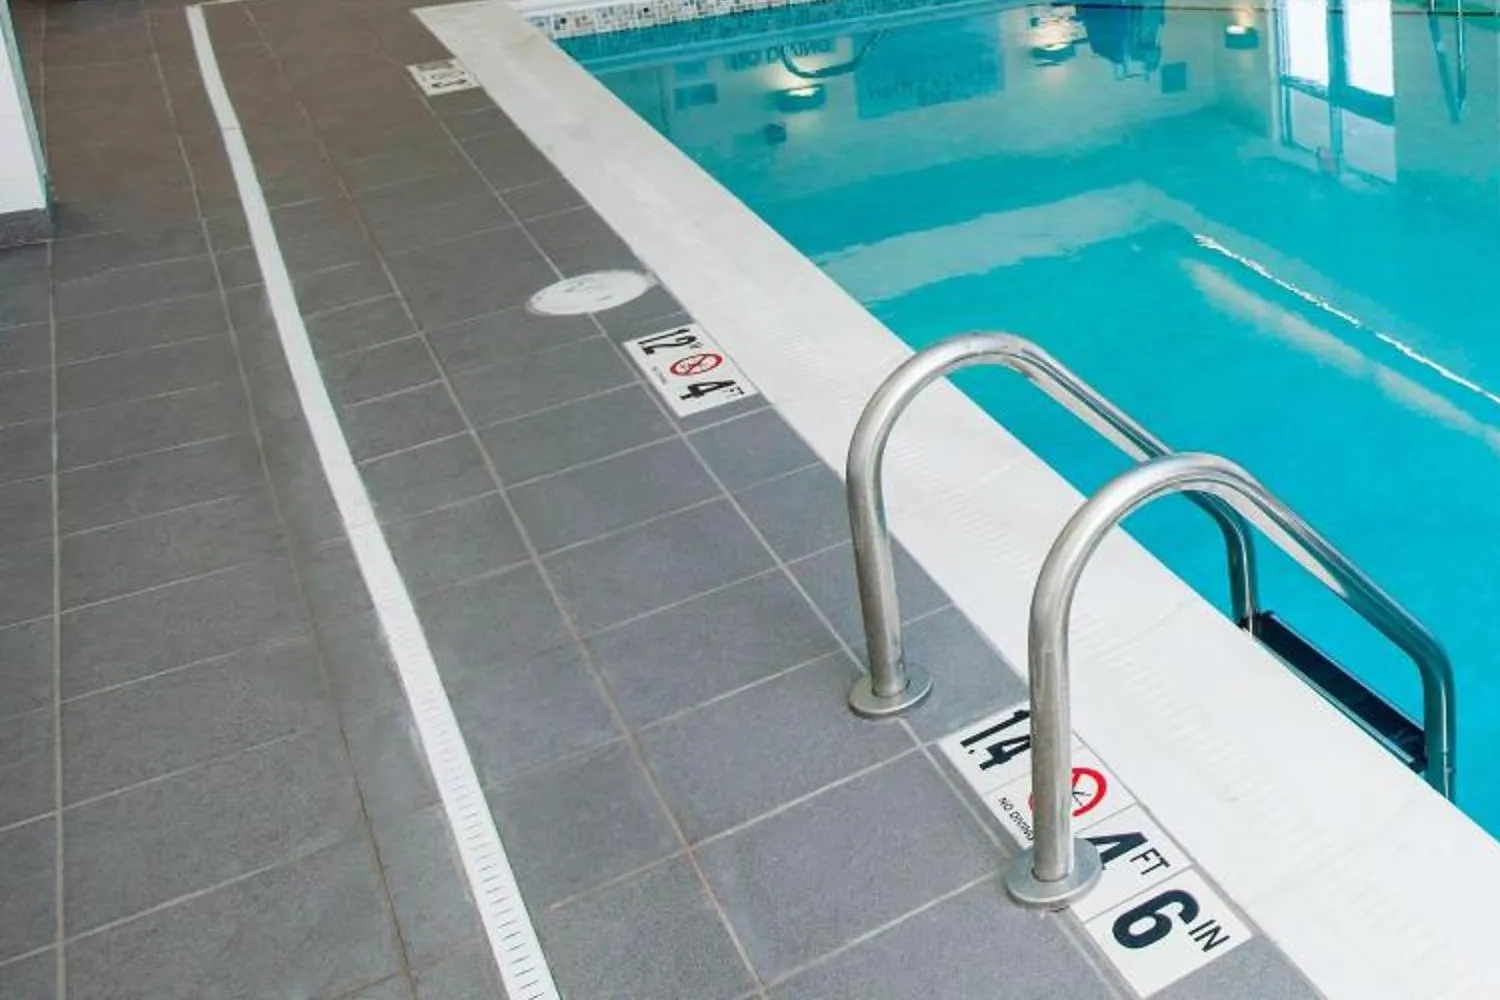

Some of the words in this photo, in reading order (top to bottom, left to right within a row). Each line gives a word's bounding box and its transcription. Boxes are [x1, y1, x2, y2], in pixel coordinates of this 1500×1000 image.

[638, 328, 697, 356] 12
[680, 380, 736, 400] 4
[999, 797, 1014, 811] NO
[1129, 847, 1171, 875] FT
[1112, 889, 1200, 949] 6
[1187, 918, 1231, 953] IN
